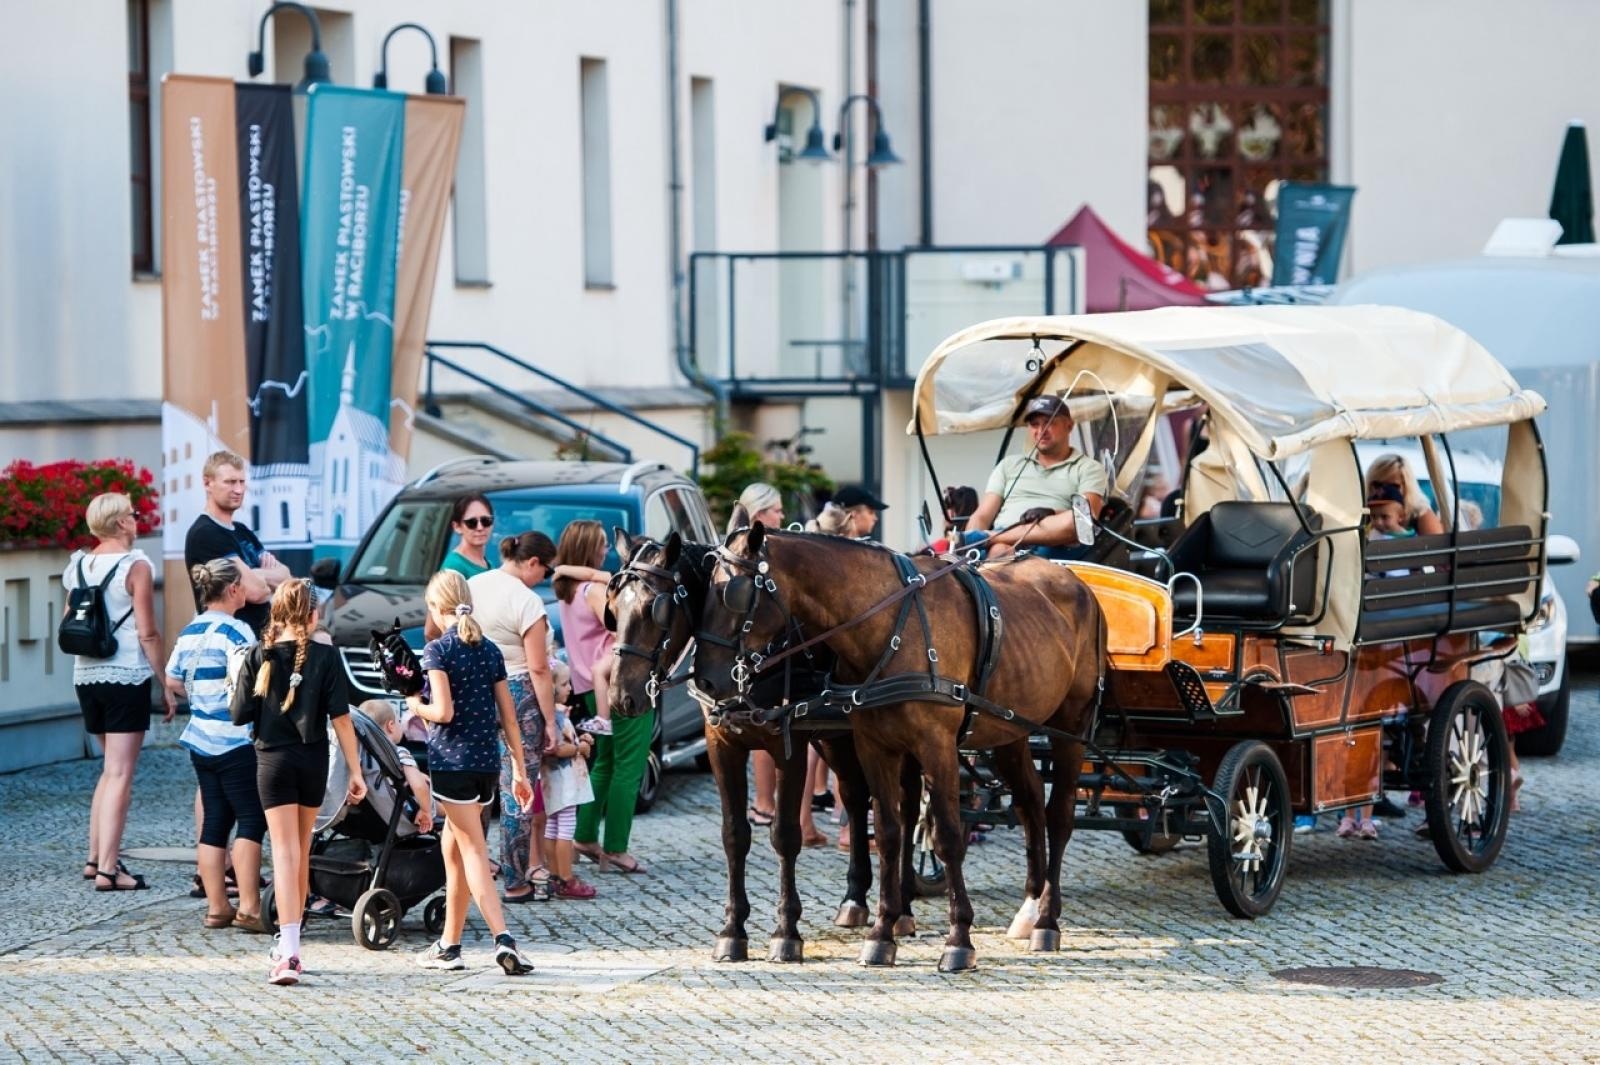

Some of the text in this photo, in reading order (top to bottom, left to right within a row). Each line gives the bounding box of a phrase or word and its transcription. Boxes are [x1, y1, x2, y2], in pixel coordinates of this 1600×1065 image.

[190, 116, 211, 320] ZAMEK PIASTOWSKI
[248, 124, 263, 321] ZAMEK PIASTOWSKI
[330, 126, 356, 319] ZAMEK PIASTOWSKI
[345, 185, 369, 320] W RACIBORZU
